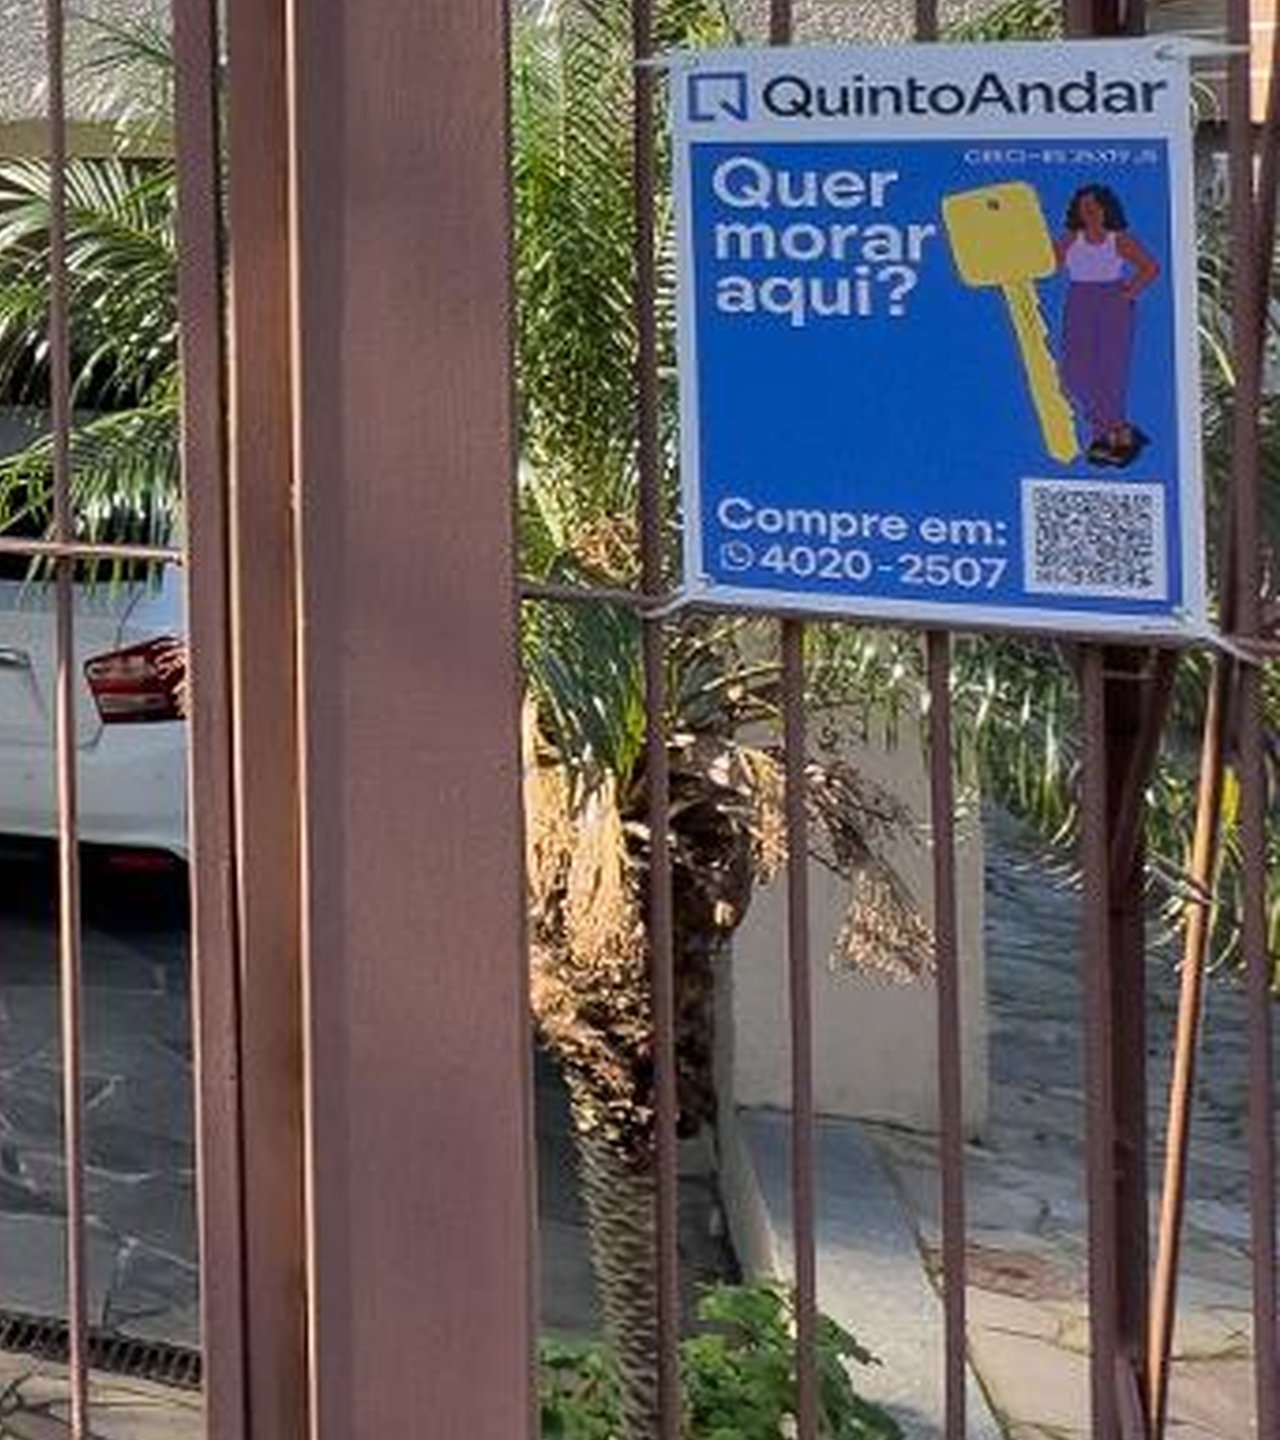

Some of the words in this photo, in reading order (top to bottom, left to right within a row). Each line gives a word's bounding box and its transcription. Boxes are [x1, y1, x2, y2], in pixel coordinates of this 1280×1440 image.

[762, 71, 1168, 119] QuintoAndar
[712, 156, 899, 209] Quer
[716, 220, 937, 261] morar
[716, 266, 918, 326] aqui?
[717, 497, 909, 544] Compre
[919, 516, 1008, 547] em:
